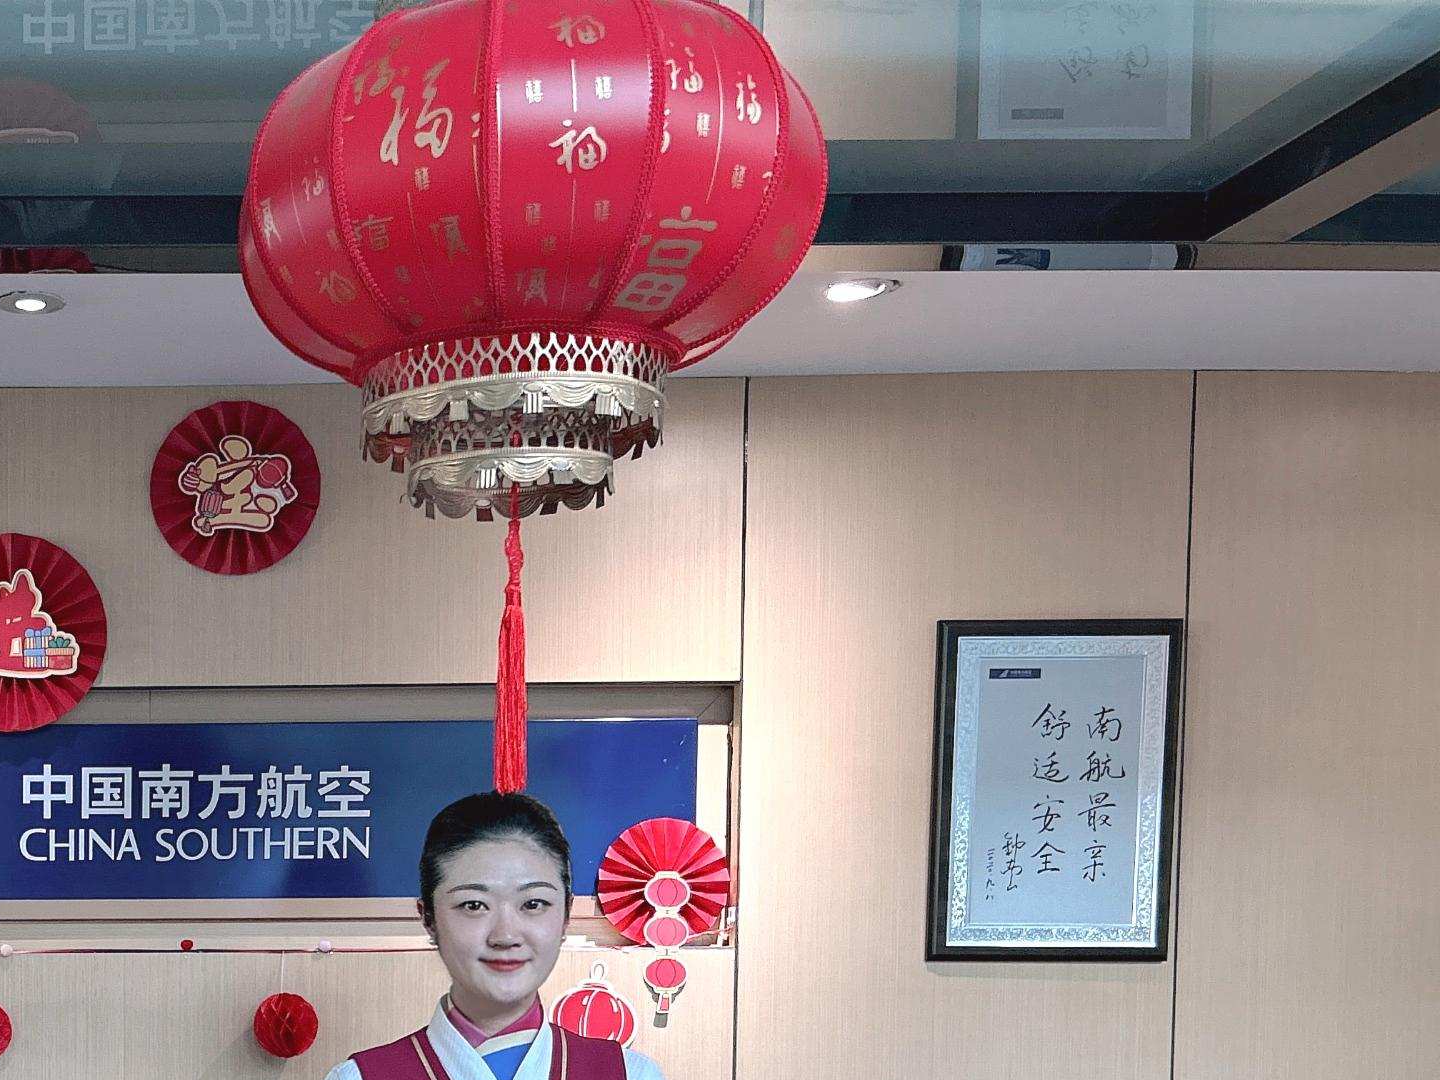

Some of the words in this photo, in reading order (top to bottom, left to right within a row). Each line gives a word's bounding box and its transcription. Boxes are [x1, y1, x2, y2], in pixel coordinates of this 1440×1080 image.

[548, 118, 608, 174] 福
[22, 763, 371, 820] 中国南方航空
[1031, 703, 1072, 874] 舒适安全
[1077, 705, 1126, 883] 南航最亲
[19, 828, 142, 862] CHINA
[155, 826, 370, 862] SOUTHERN
